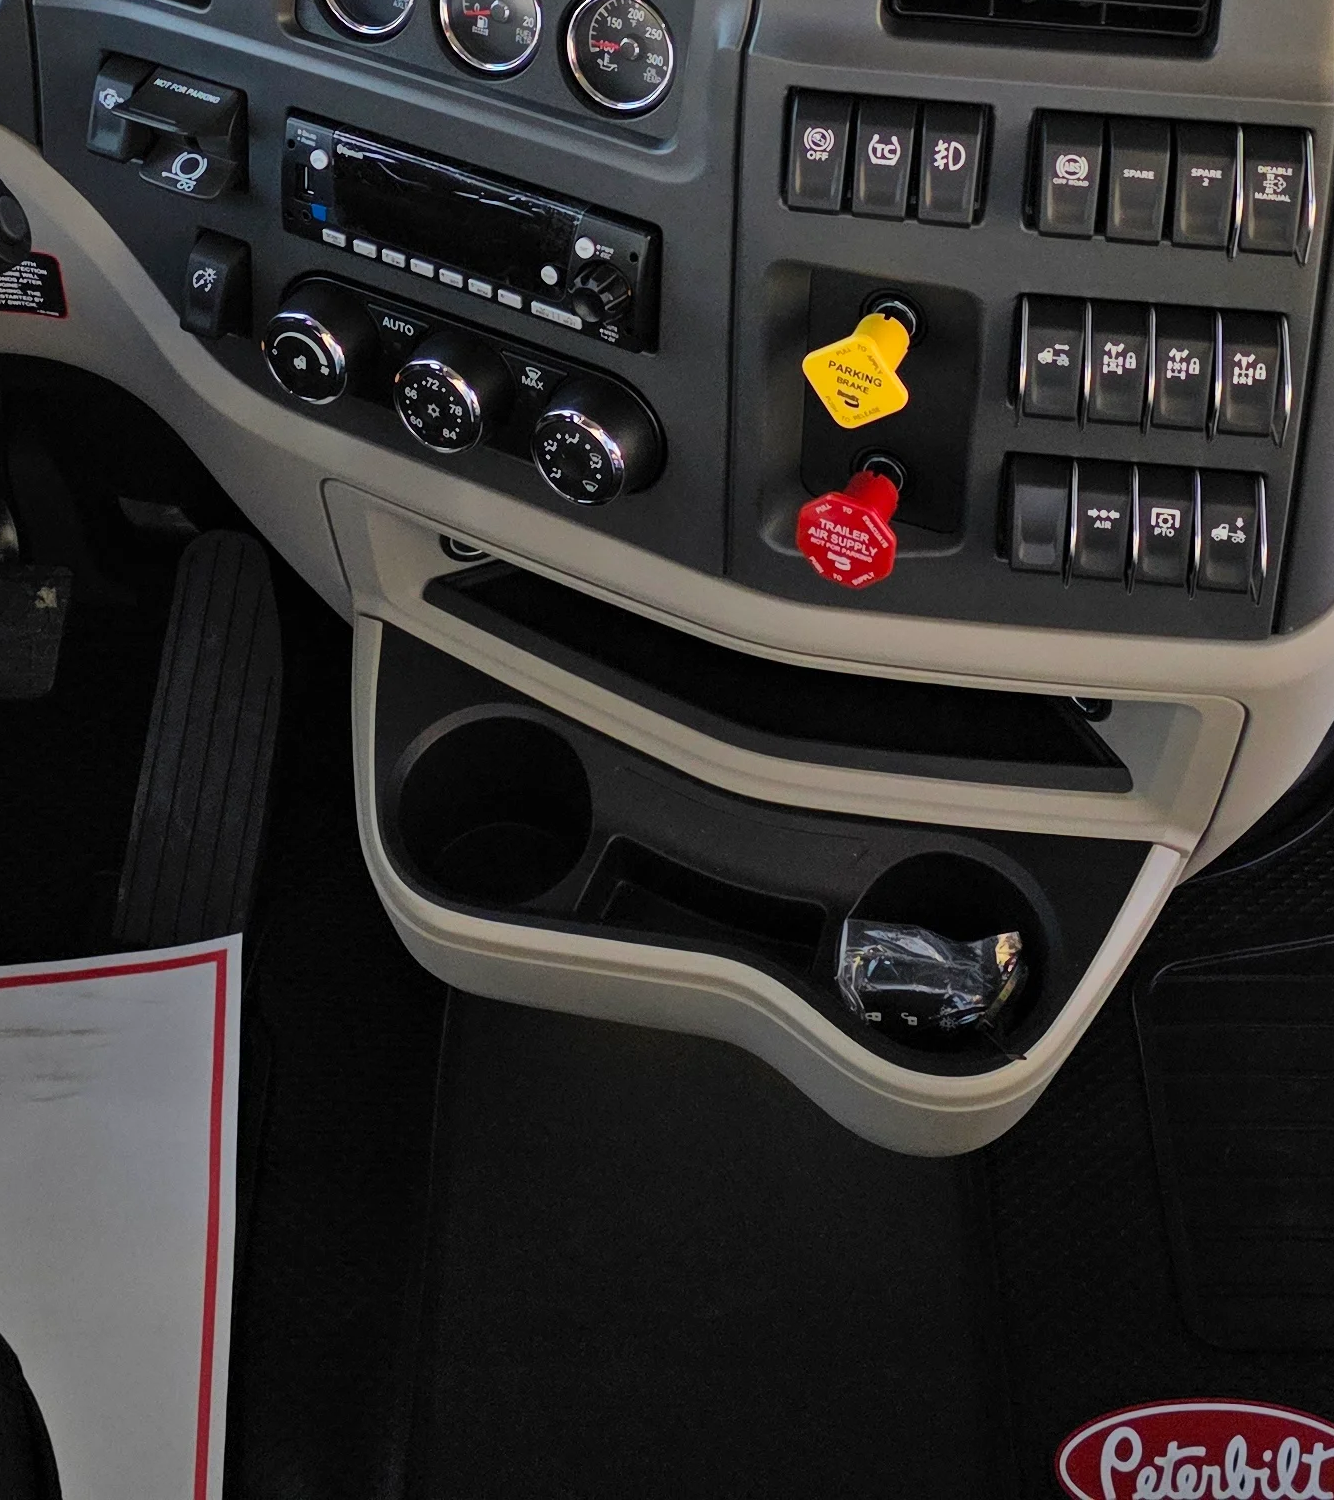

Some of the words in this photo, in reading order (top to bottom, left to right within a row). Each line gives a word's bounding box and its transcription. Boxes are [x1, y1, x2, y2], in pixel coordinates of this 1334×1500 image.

[627, 7, 645, 21] 200
[522, 15, 534, 28] 20
[606, 16, 623, 30] 150
[515, 27, 532, 38] FUEL
[645, 26, 662, 40] 250
[646, 52, 664, 66] 300
[153, 78, 172, 89] NOT
[170, 83, 188, 94] FOR
[186, 88, 221, 104] PARKING
[806, 150, 829, 161] OFF
[873, 143, 896, 159] TC
[1123, 168, 1154, 180] SPARE
[1190, 168, 1222, 179] SPARE
[1257, 165, 1293, 176] DISABLE
[1202, 177, 1209, 186] 2
[1254, 192, 1291, 202] MANUAL
[382, 315, 414, 337] AUTO
[828, 360, 883, 388] PARKING
[426, 377, 439, 391] 72
[521, 375, 544, 391] MAX
[836, 376, 869, 395] BRAKE
[404, 386, 418, 400] 66
[448, 403, 463, 417] 78
[409, 415, 424, 428] 60
[442, 428, 457, 441] 84
[842, 505, 853, 515] TO
[819, 518, 870, 544] TRAILER
[1094, 519, 1112, 529] AIR
[1153, 527, 1175, 537] PTO
[807, 526, 828, 541] AIR
[830, 533, 878, 557] SUPPLY
[832, 573, 843, 582] TO
